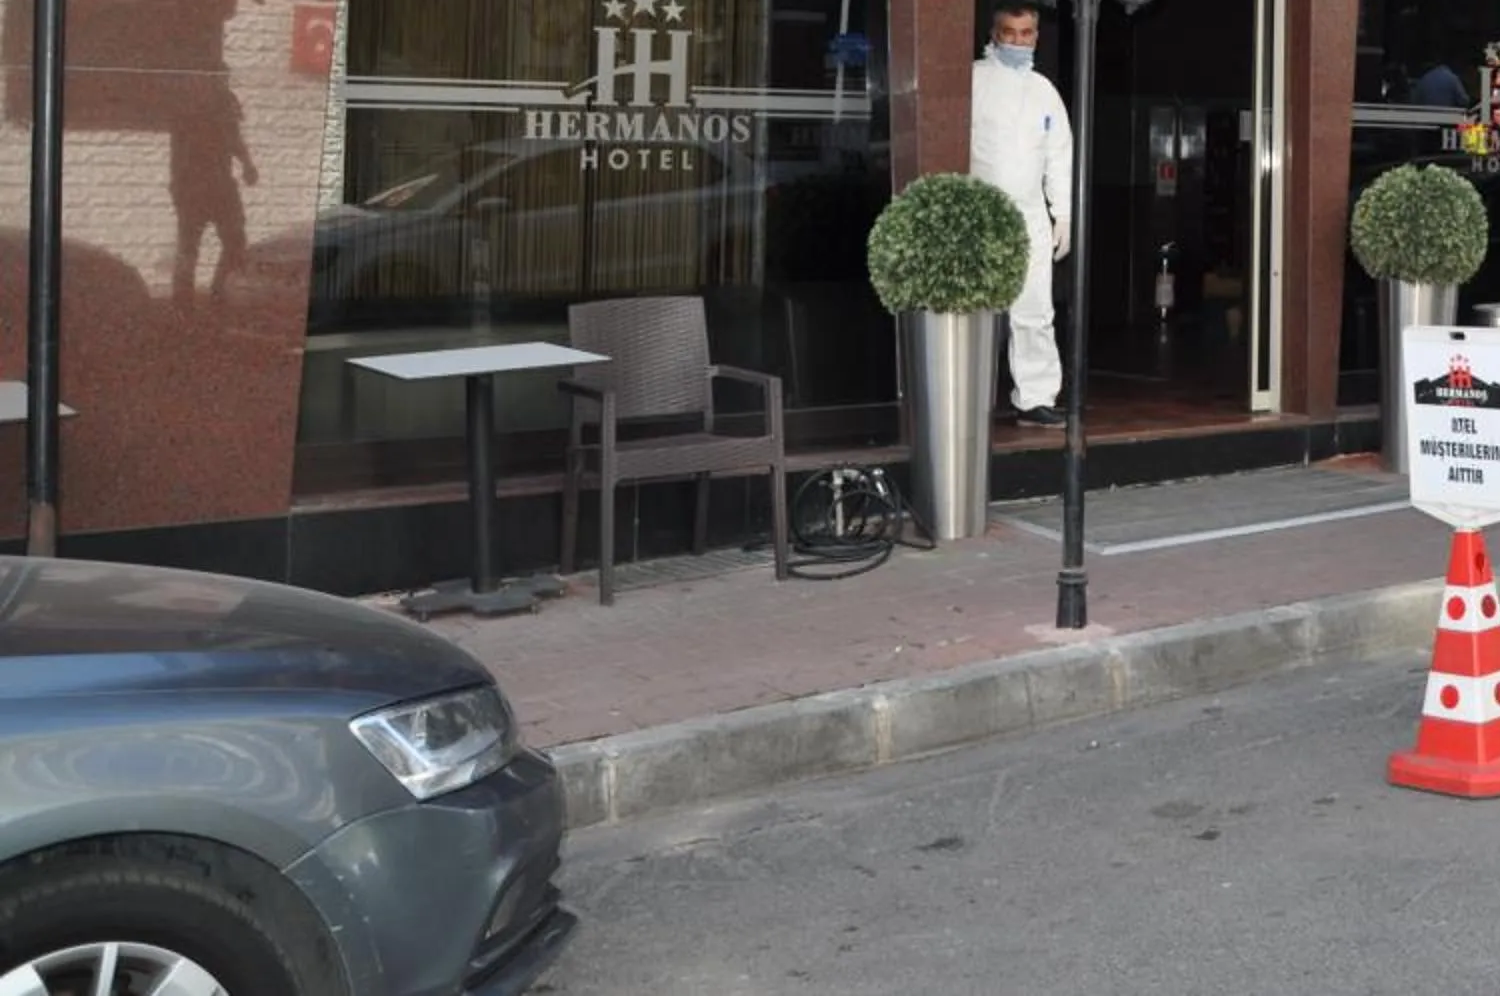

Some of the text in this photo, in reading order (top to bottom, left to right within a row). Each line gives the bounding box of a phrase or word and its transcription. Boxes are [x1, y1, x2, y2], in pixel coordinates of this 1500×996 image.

[523, 110, 751, 144] HERMANOS
[580, 149, 694, 172] HOTEL
[1435, 387, 1488, 400] HERMANOS
[1450, 417, 1478, 435] OTEL
